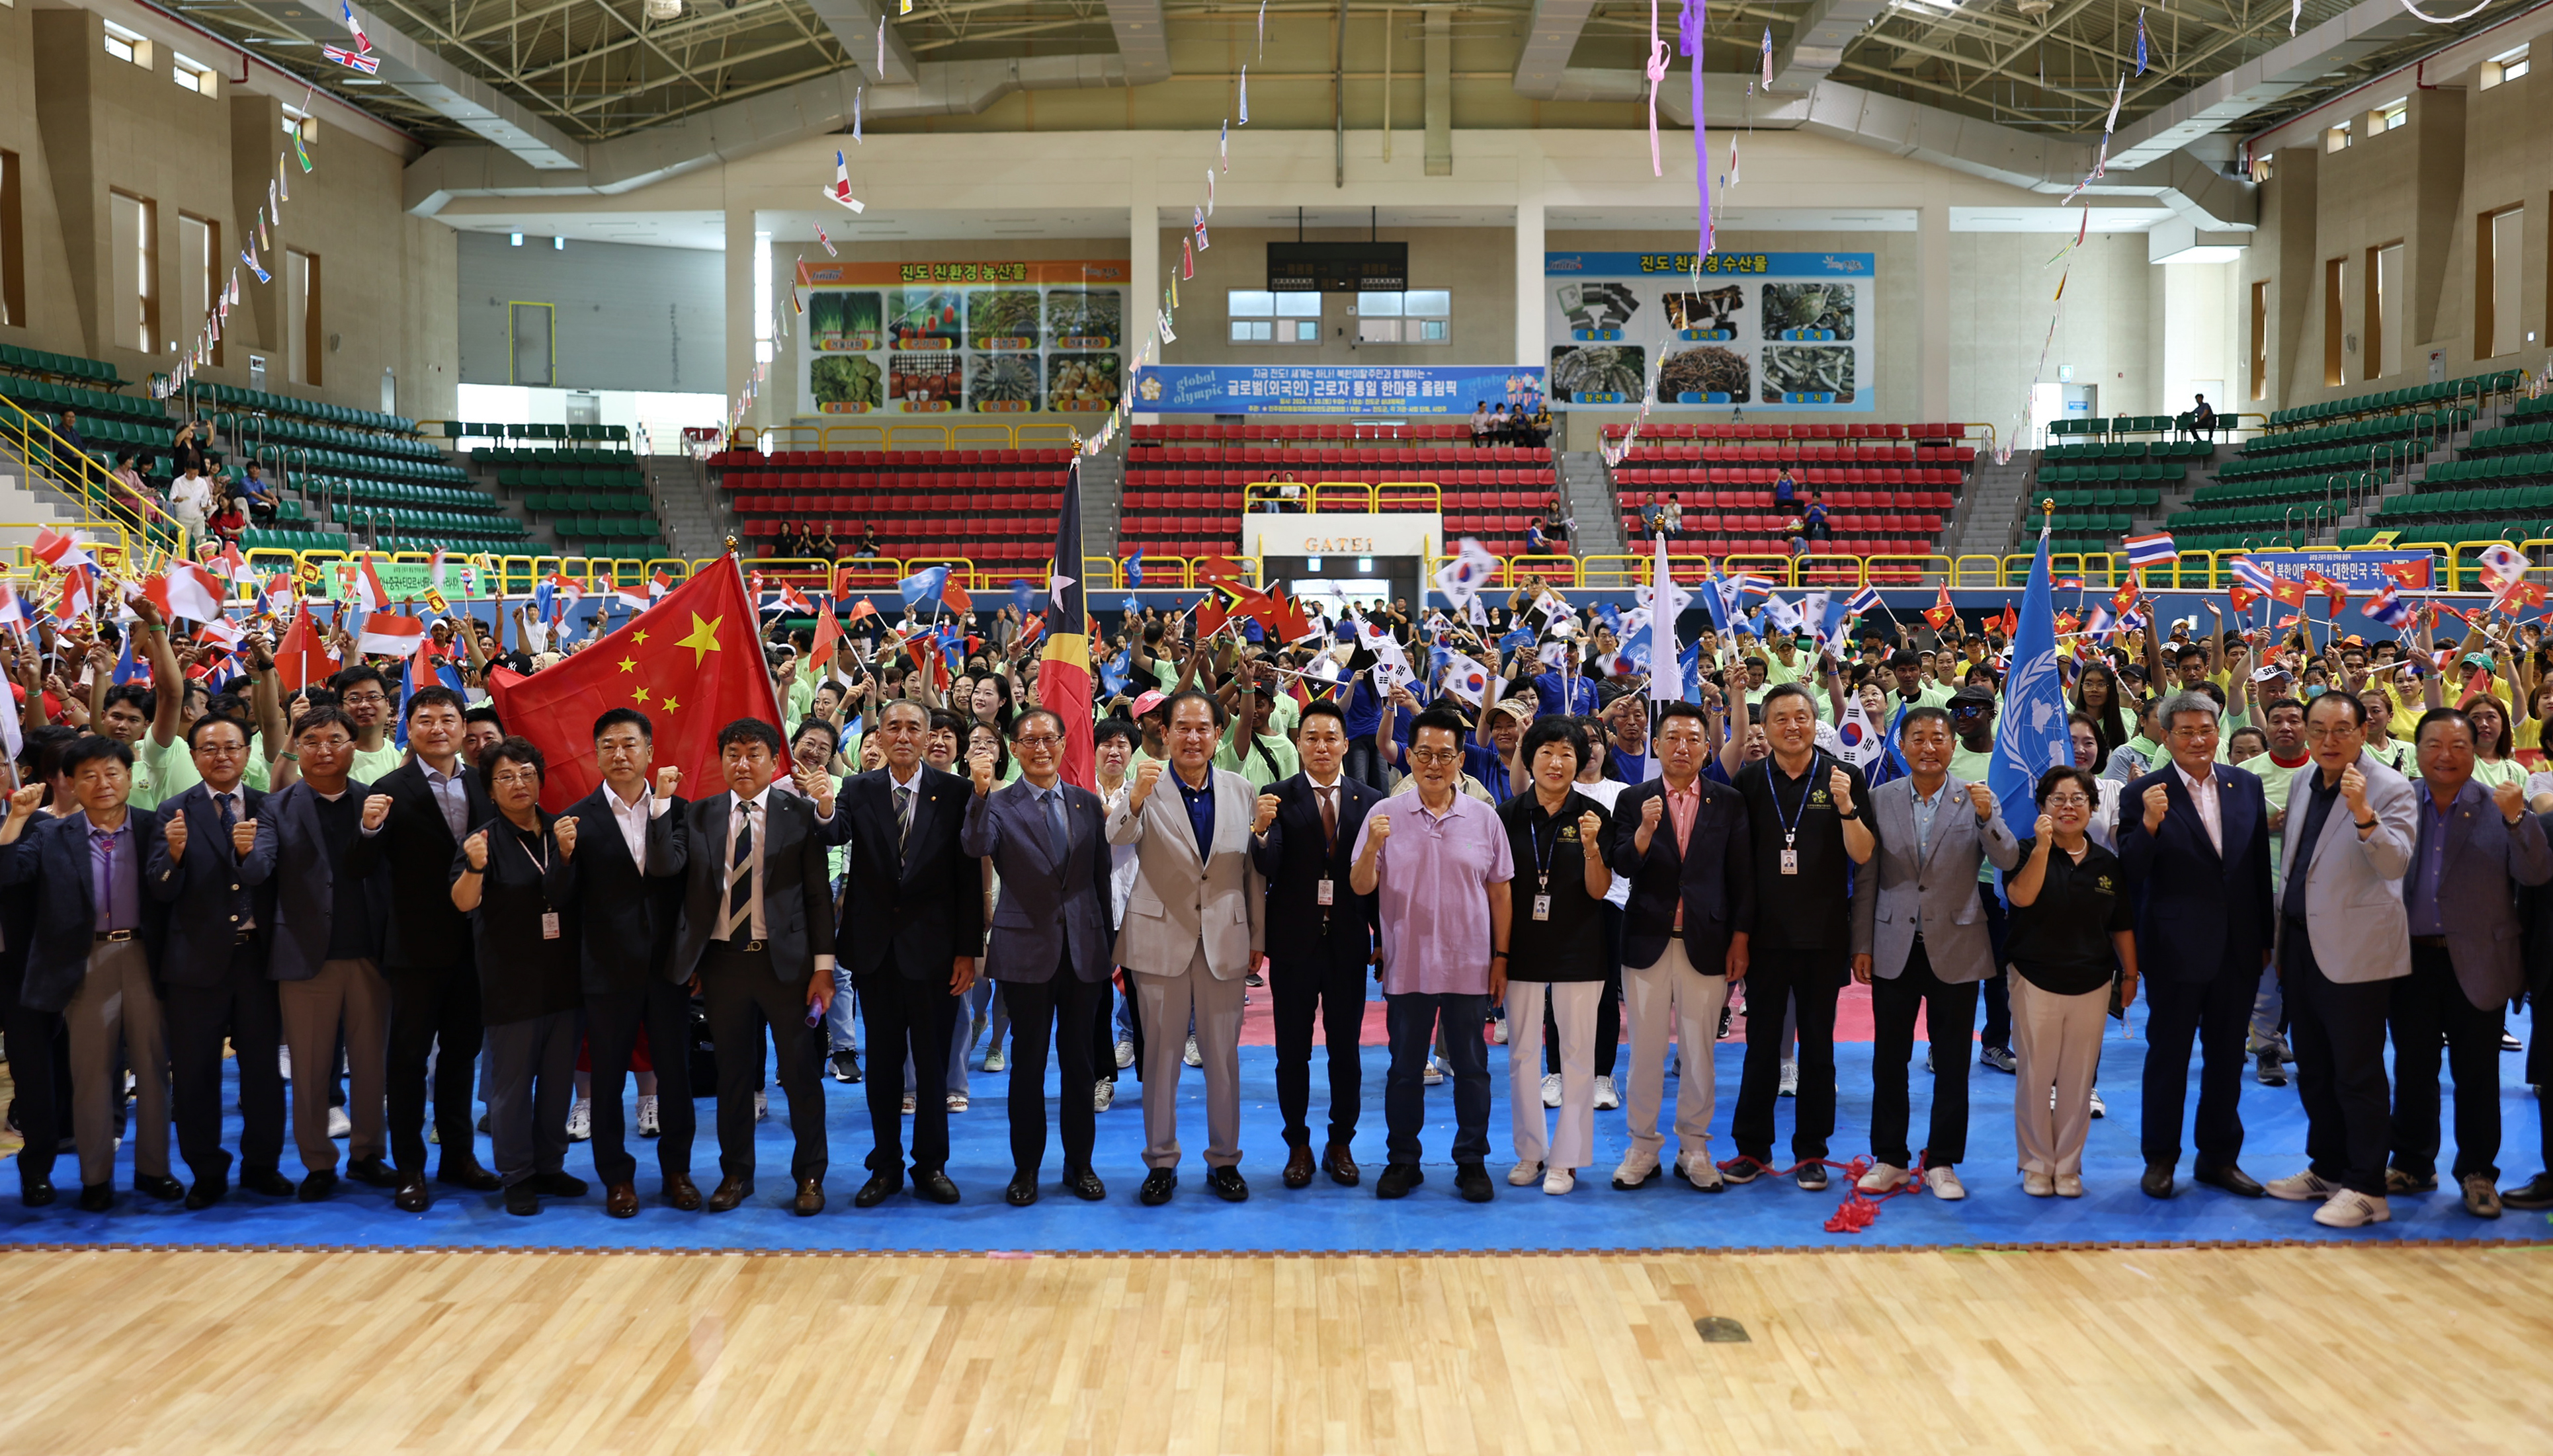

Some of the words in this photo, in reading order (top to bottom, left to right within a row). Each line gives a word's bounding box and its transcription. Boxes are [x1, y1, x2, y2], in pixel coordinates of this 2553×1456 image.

[1640, 255, 1671, 272] 진도
[1722, 255, 1768, 272] 수산물
[901, 263, 930, 282] 진도
[933, 263, 978, 281] 친환경
[982, 263, 1027, 281] 농산물
[1176, 370, 1216, 392] global
[1253, 368, 1268, 380] 지금
[1271, 368, 1288, 380] 진도!
[1291, 368, 1314, 380] 세계는
[1316, 368, 1335, 380] 하나!
[1337, 368, 1391, 380] 북한이탈주민과
[1393, 368, 1425, 380] 함께하는
[1173, 384, 1224, 405] olympic
[1228, 380, 1309, 397] 글로벌(외국인)
[1314, 380, 1350, 397] 근로자
[1353, 380, 1376, 397] 통일
[1381, 380, 1417, 397] 한마음
[1421, 380, 1457, 397] 올림픽
[1304, 537, 1374, 552] GATE1
[2263, 665, 2278, 676] SEO
